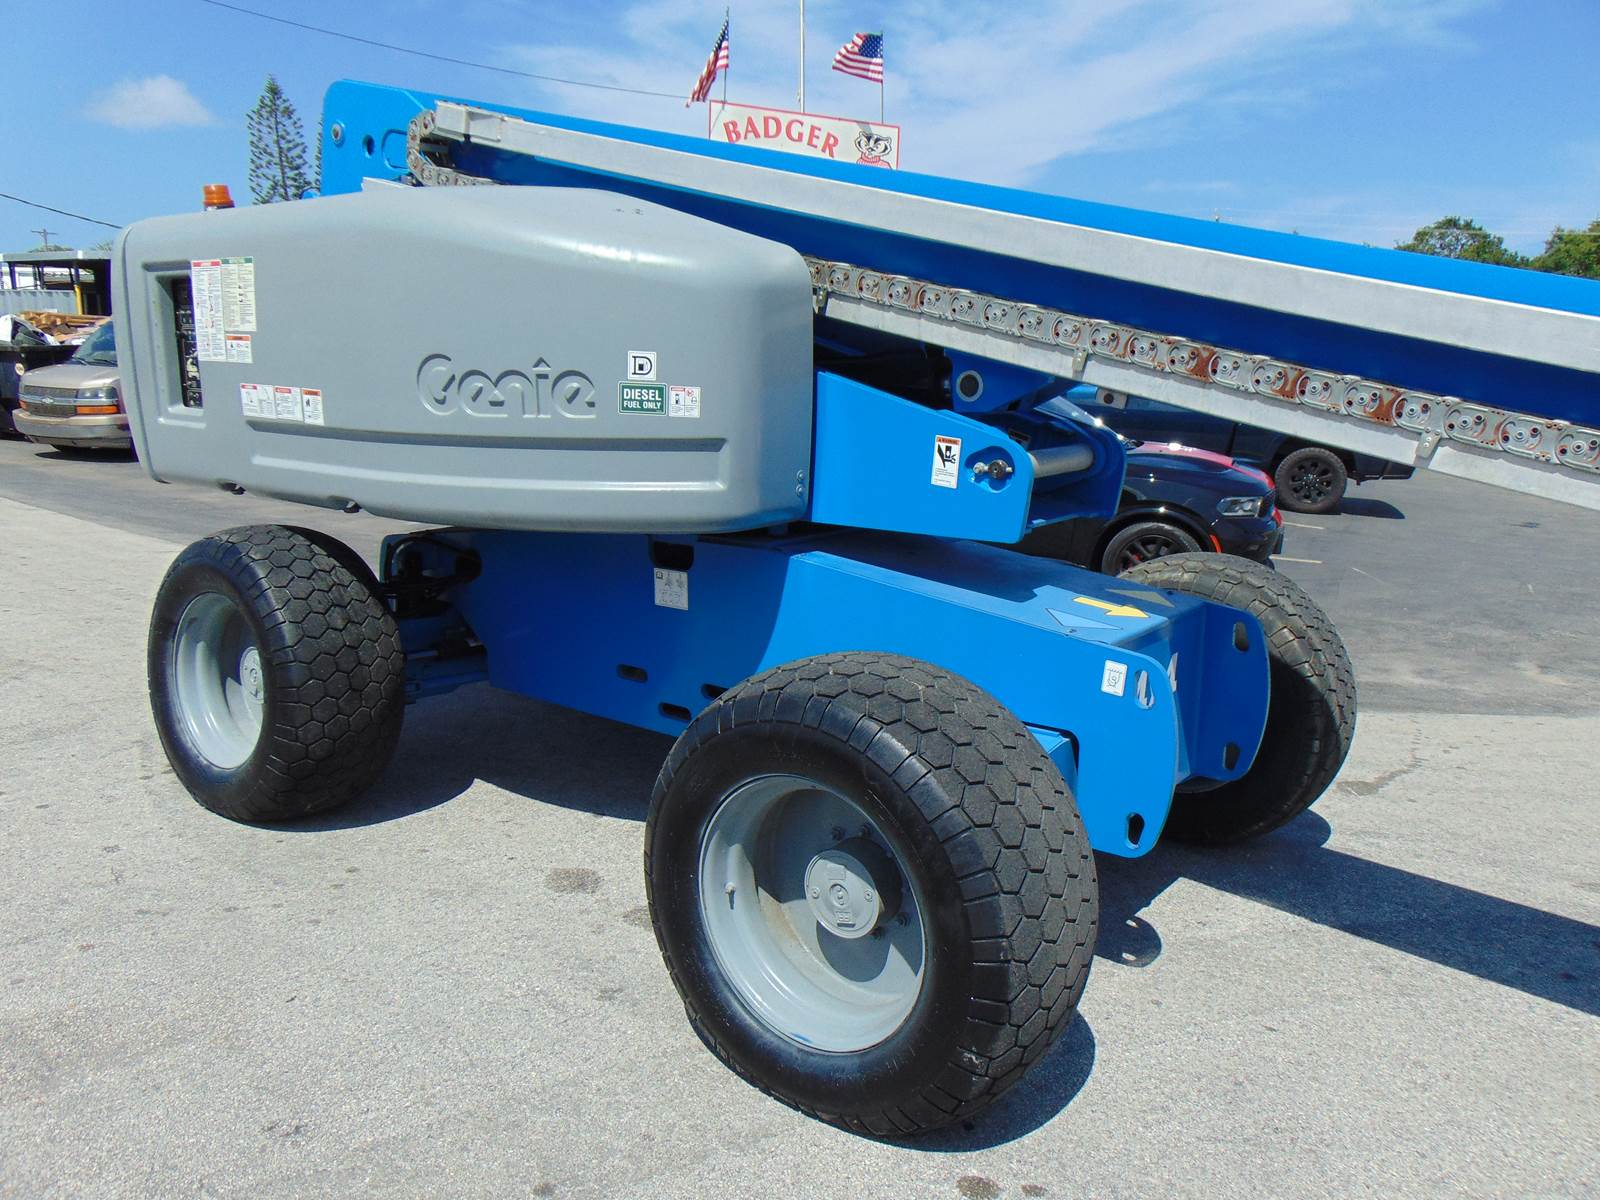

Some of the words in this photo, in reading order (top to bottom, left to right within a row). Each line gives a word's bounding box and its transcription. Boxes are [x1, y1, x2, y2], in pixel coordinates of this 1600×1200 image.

[723, 116, 840, 158] BADGER
[632, 355, 653, 376] D
[416, 353, 597, 419] Genie
[623, 388, 662, 401] DIESEL
[623, 401, 642, 409] FUEL
[643, 401, 662, 410] ONLY
